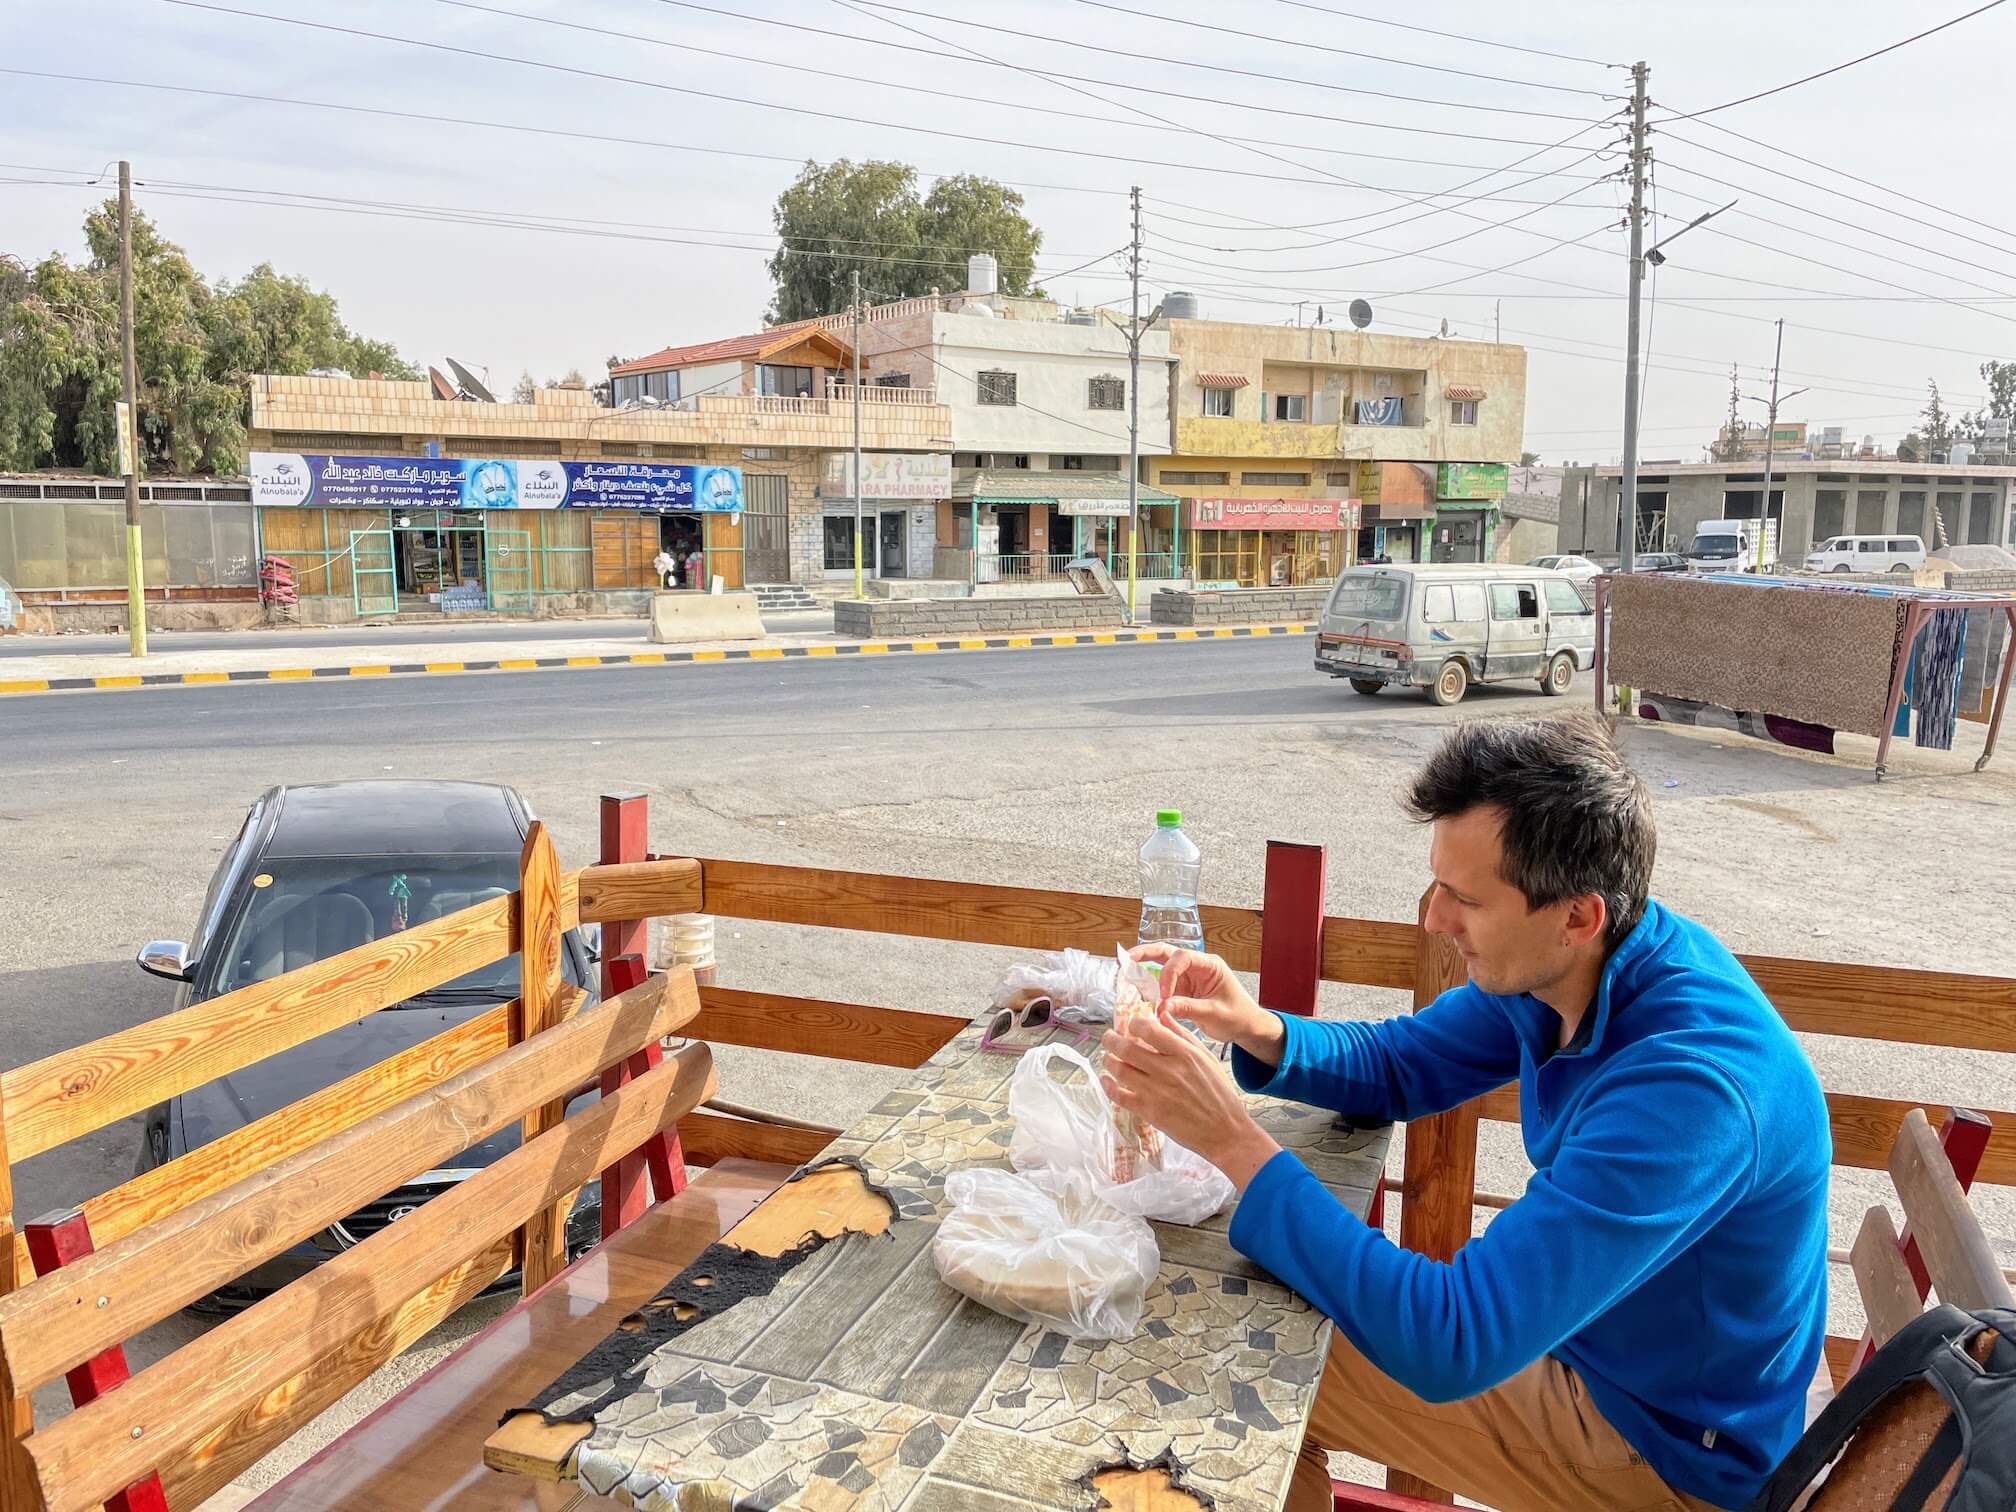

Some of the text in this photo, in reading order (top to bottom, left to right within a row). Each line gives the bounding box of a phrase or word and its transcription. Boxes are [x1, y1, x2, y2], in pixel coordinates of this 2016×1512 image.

[362, 465, 383, 480] خالد
[385, 466, 430, 484] ماركت
[431, 470, 468, 486] سوبر
[884, 483, 947, 496] PHARMACY
